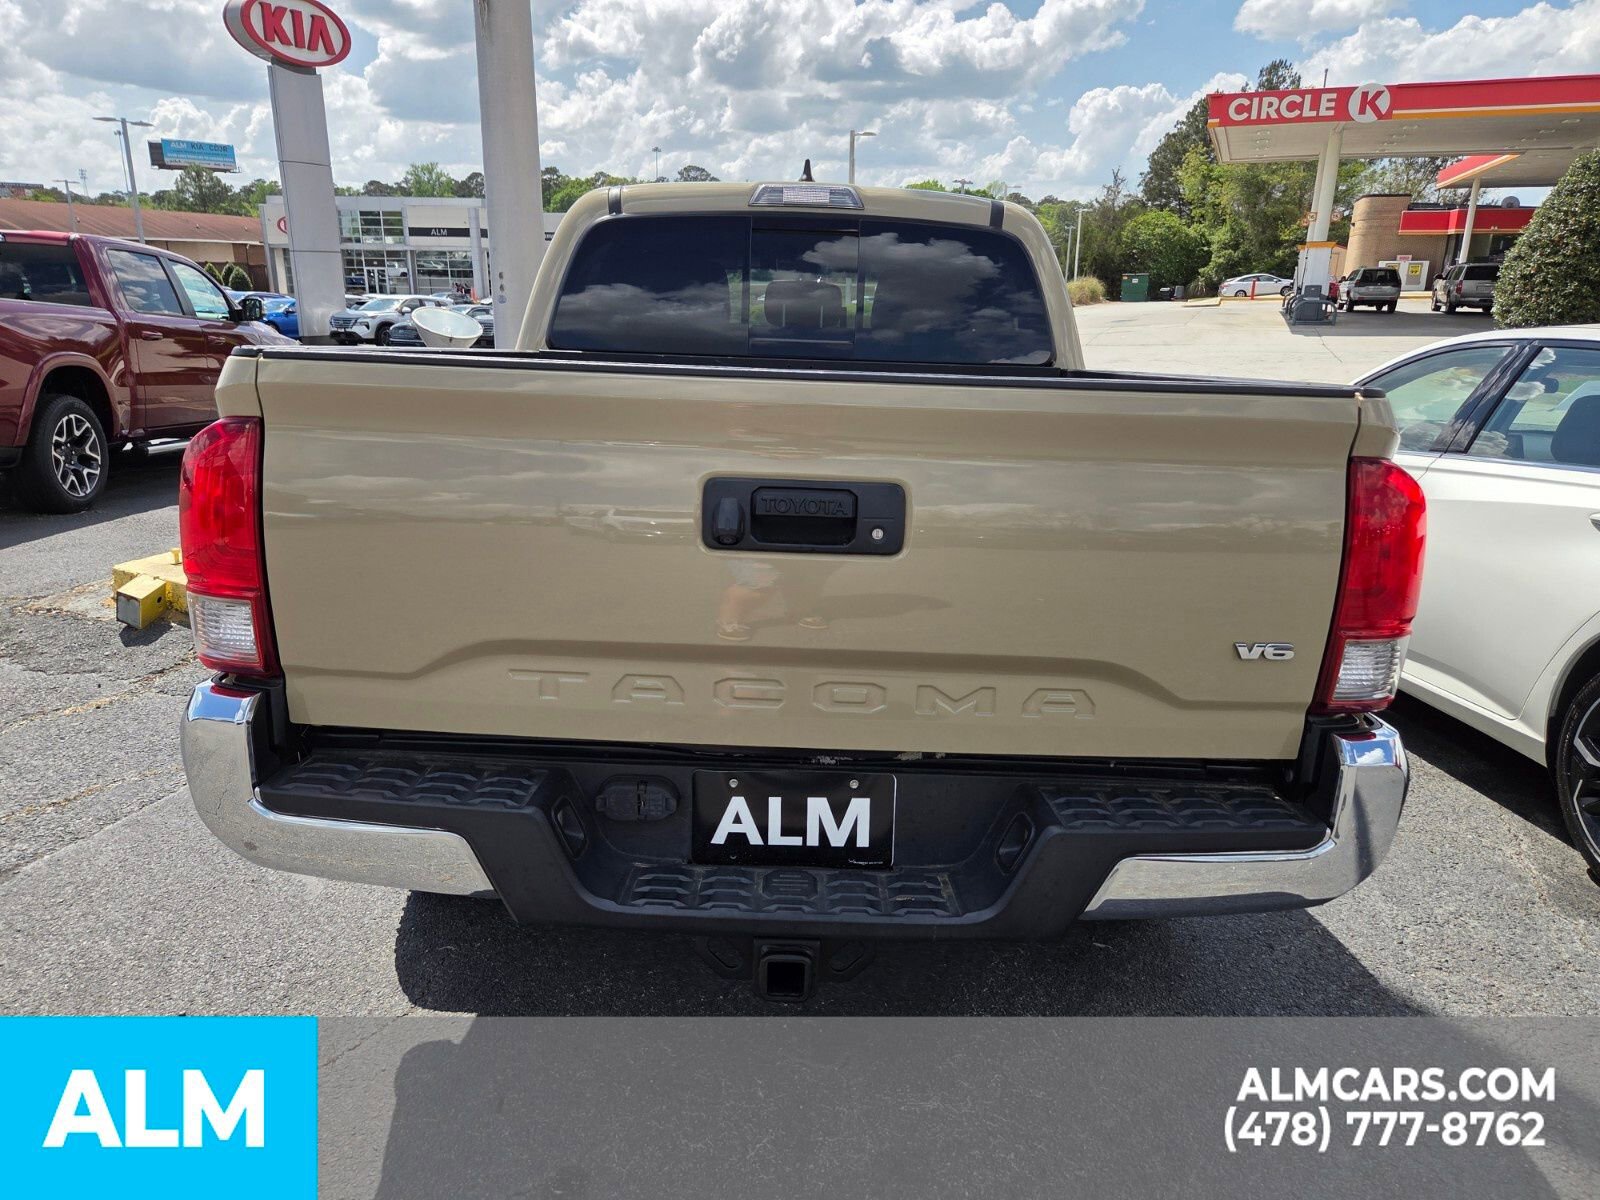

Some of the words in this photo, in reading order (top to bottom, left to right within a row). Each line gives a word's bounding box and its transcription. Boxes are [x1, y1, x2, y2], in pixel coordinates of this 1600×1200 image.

[258, 1, 336, 55] KIA
[1228, 93, 1338, 121] CIRCLE
[1358, 89, 1386, 120] K
[170, 141, 187, 149] ALM
[190, 143, 204, 151] KIA
[430, 227, 448, 236] ALM
[761, 497, 849, 516] TOYOTA
[1234, 643, 1295, 660] V6
[507, 668, 1096, 719] TACOMA
[710, 796, 871, 848] ALM
